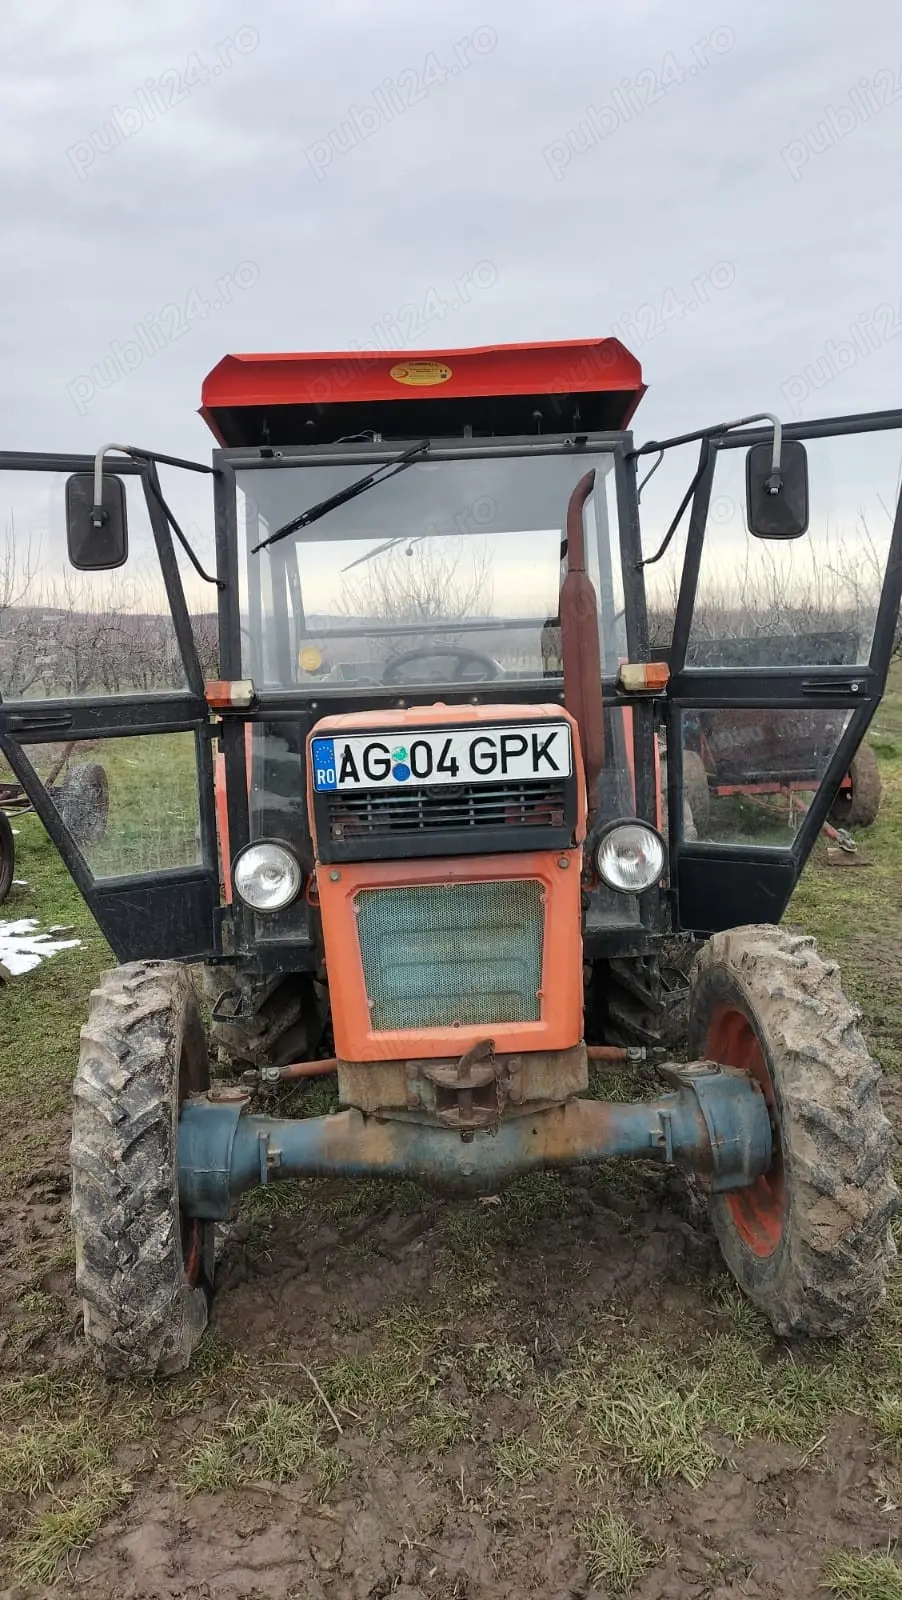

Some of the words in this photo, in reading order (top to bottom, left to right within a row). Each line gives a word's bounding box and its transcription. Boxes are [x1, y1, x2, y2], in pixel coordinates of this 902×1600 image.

[338, 743, 391, 783] AG
[410, 738, 459, 778] 04
[469, 731, 560, 775] GPK
[317, 769, 335, 785] RO
